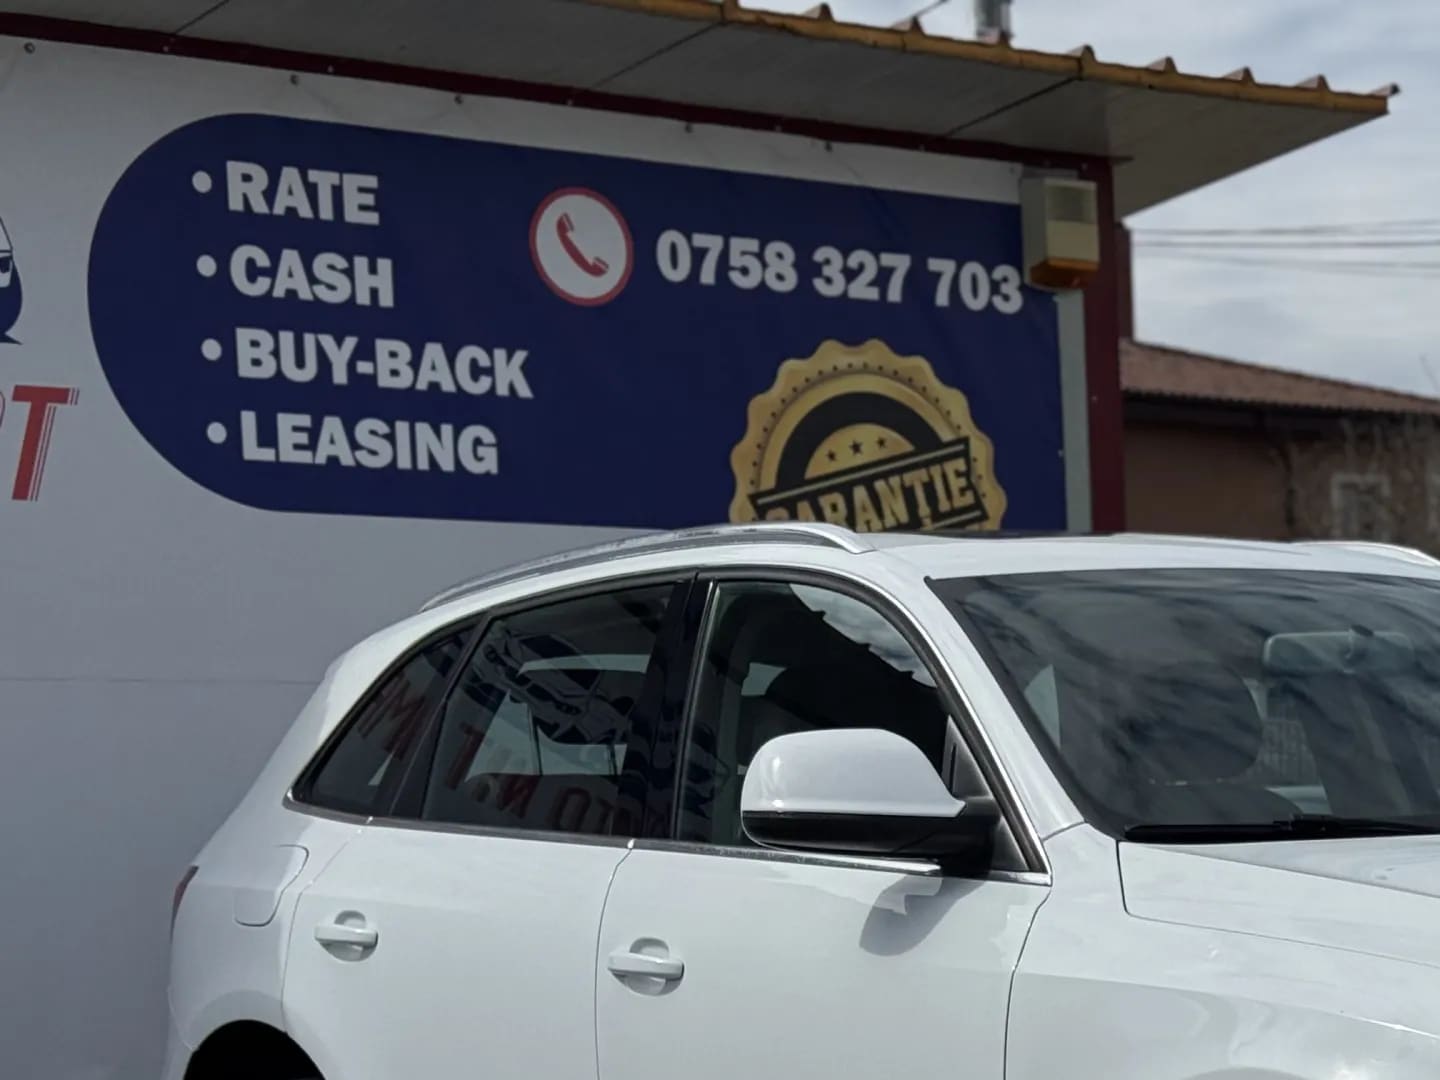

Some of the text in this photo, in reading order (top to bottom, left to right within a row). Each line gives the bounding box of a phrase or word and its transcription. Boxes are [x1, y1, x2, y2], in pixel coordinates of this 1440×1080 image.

[226, 160, 380, 225] RATE
[229, 245, 395, 307] CASH
[656, 229, 1023, 314] 0758 327 703
[235, 327, 534, 399] BUY-BACK
[0, 384, 80, 502] T
[240, 410, 499, 475] LEASING
